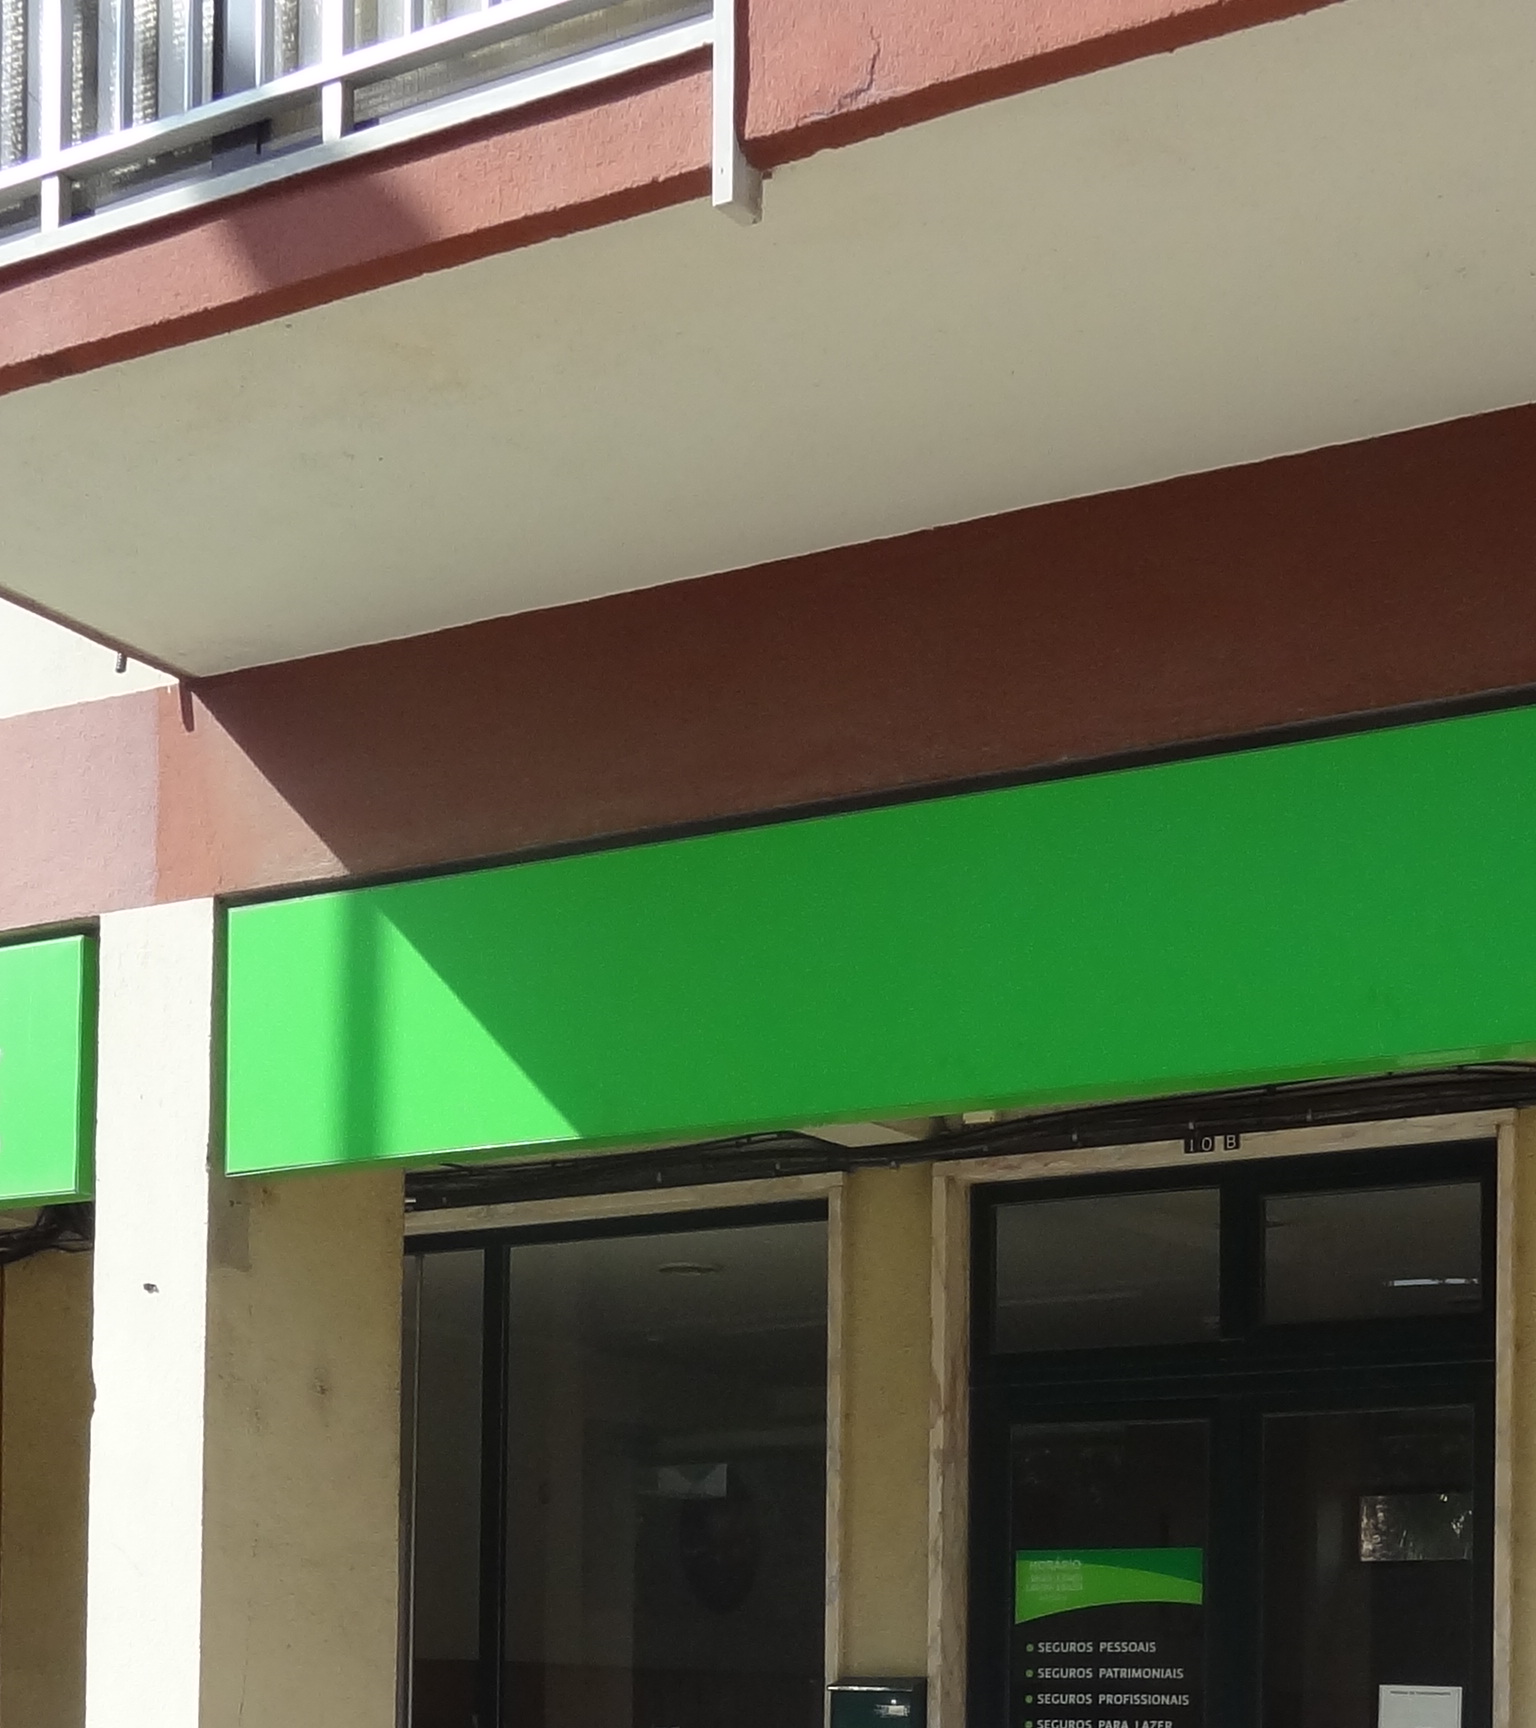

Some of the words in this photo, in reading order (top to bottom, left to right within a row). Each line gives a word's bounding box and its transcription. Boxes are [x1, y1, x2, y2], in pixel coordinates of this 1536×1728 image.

[1189, 1136, 1213, 1152] 10
[1226, 1134, 1237, 1149] B
[1037, 1641, 1093, 1653] SEGUROS
[1099, 1641, 1156, 1653] PESSOAIS
[1037, 1667, 1093, 1679] SEGUROS
[1099, 1668, 1184, 1679] PATRIMONIAIS
[1037, 1693, 1093, 1705] SEGUROS
[1098, 1694, 1190, 1706] PROFISSIONAIS
